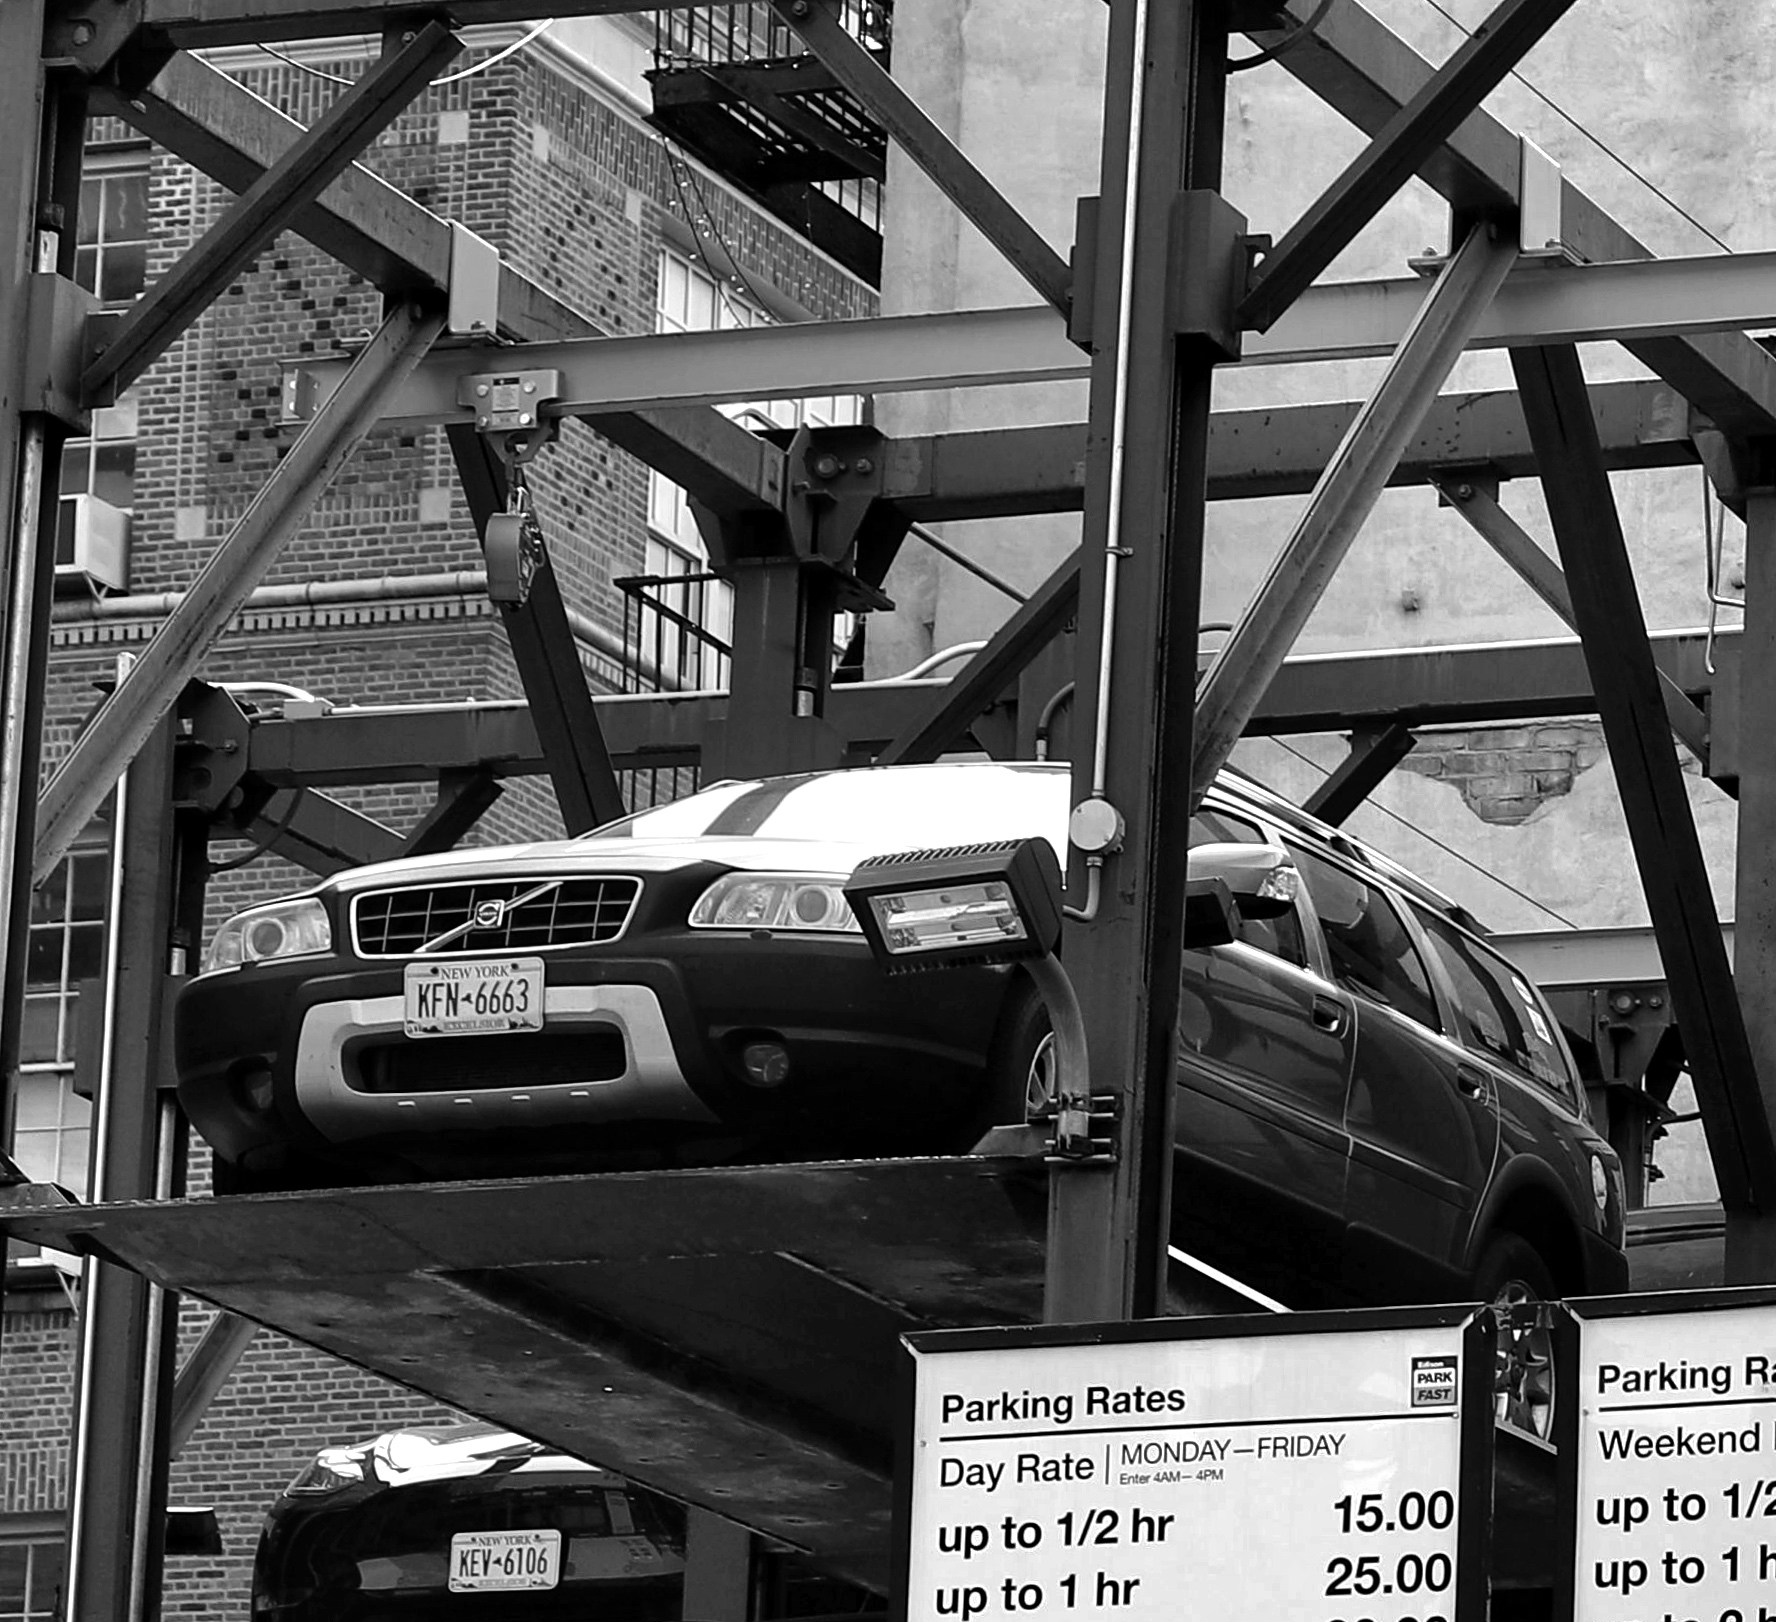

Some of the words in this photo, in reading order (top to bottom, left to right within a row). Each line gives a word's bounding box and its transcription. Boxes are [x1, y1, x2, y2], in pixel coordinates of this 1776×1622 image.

[441, 967, 471, 980] NEW
[475, 965, 509, 978] YORK
[1417, 1371, 1453, 1385] PARK
[1417, 1387, 1452, 1402] FAST
[942, 1390, 1073, 1424] Parking
[1086, 1386, 1185, 1415] Rates
[1599, 1423, 1761, 1460] Weekend
[940, 1458, 1005, 1492] Day
[1017, 1453, 1095, 1483] Rate
[939, 1525, 989, 1560] up
[1001, 1516, 1042, 1549] to
[1057, 1509, 1119, 1546] 1/2
[1132, 1508, 1174, 1543] hr
[1334, 1490, 1454, 1533] 15.00
